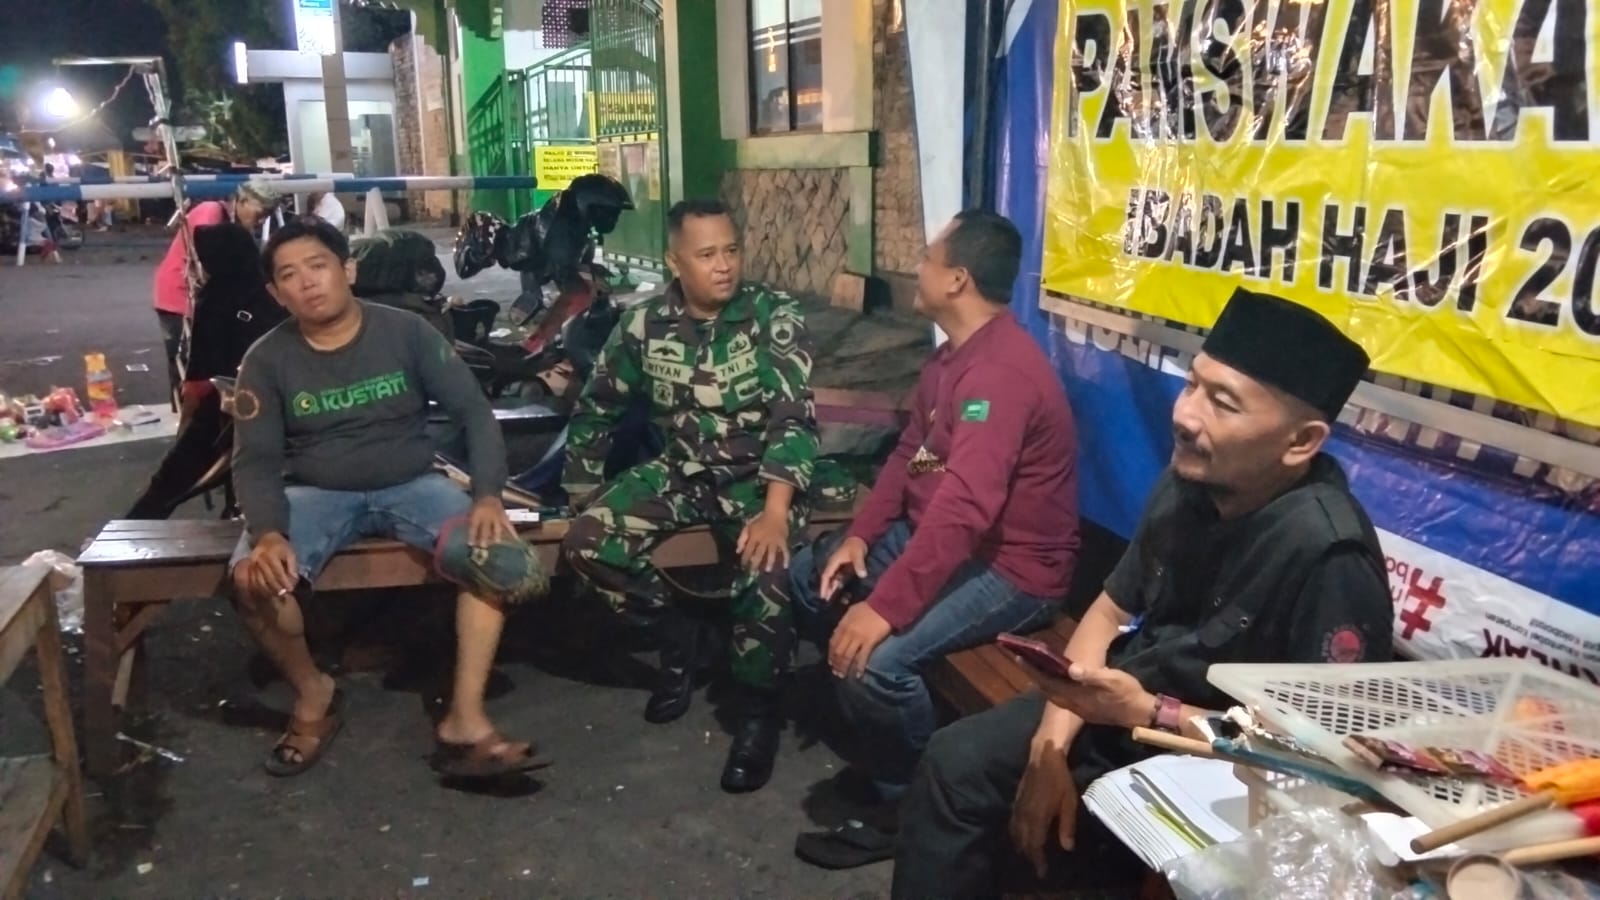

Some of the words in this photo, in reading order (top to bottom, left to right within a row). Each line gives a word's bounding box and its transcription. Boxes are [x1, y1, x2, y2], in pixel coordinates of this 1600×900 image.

[1123, 188, 1300, 283] IBADAH
[1318, 204, 1489, 313] HAJI
[720, 361, 740, 377] TNI
[745, 357, 755, 368] A
[321, 375, 408, 411] KUSTATI
